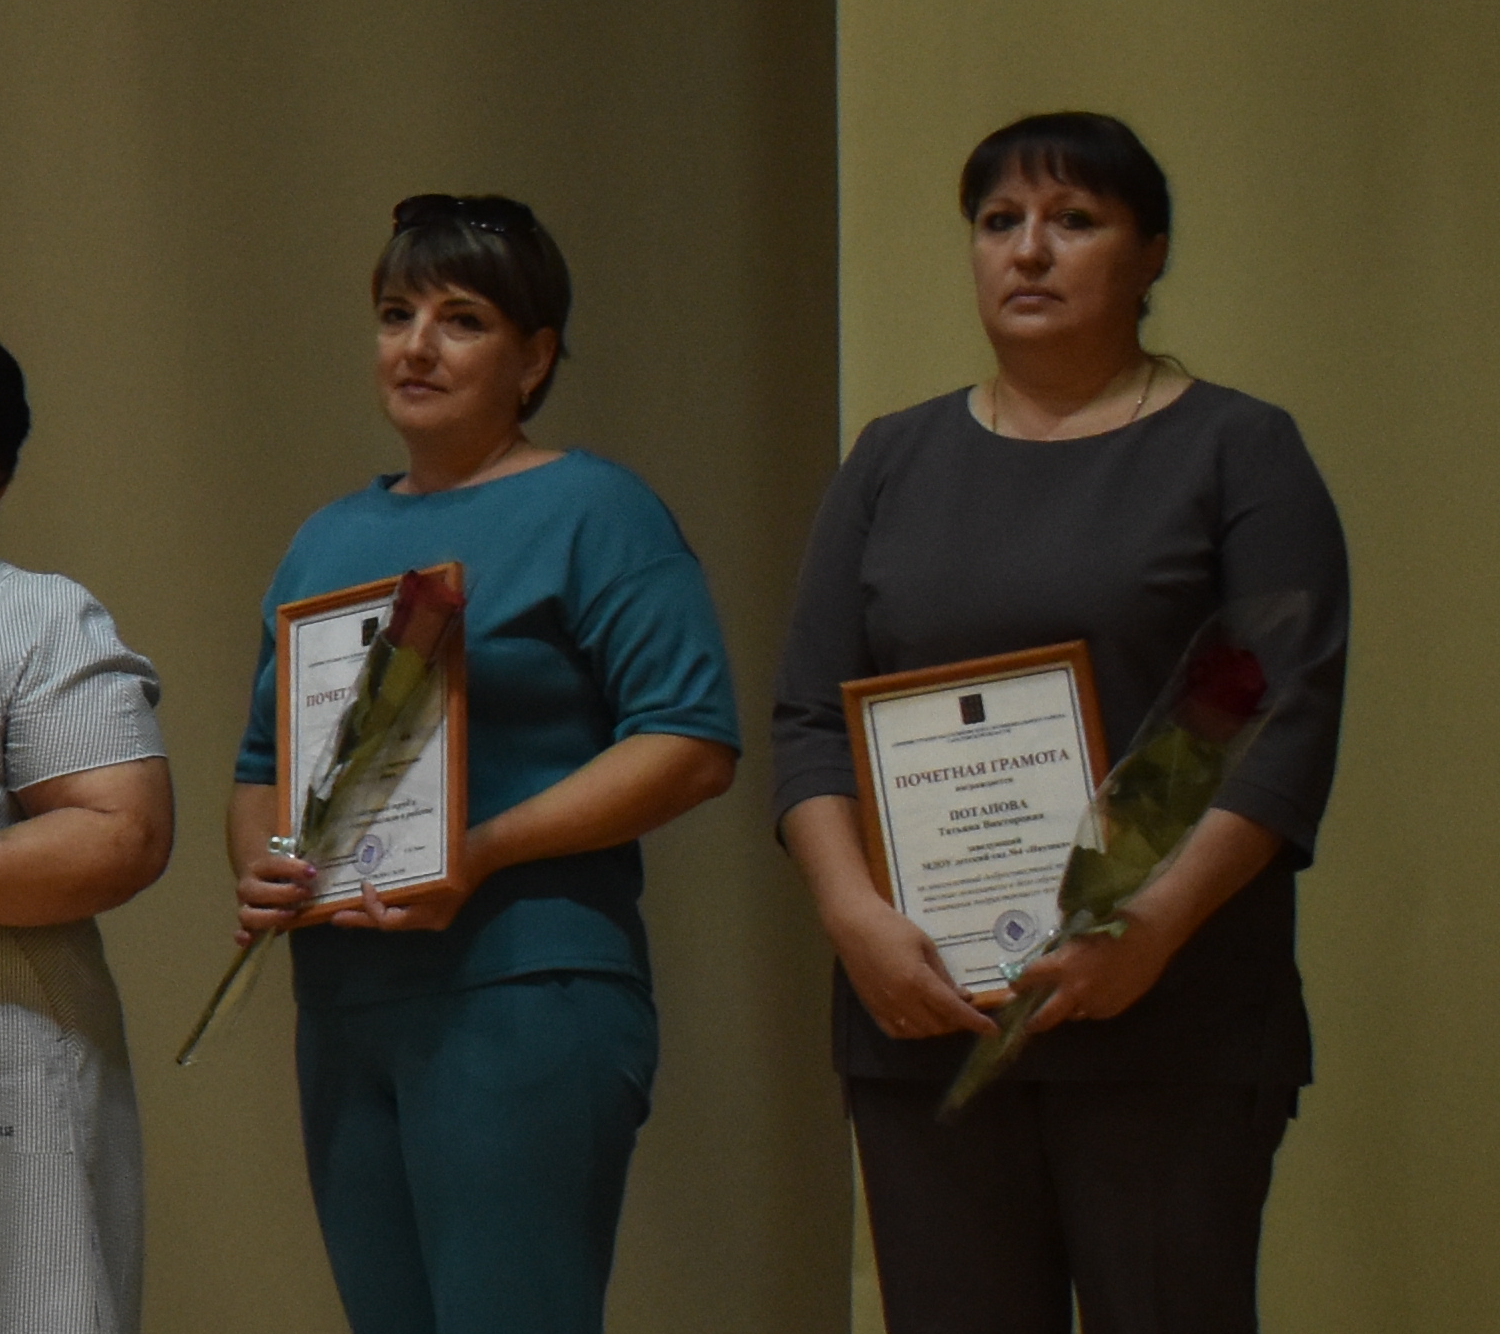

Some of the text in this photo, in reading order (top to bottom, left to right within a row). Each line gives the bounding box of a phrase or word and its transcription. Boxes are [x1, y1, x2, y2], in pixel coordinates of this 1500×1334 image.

[894, 746, 1070, 789] ПОЧЕТНАЯ ГРАМОТА
[947, 797, 1028, 821] ПОТАПОВА
